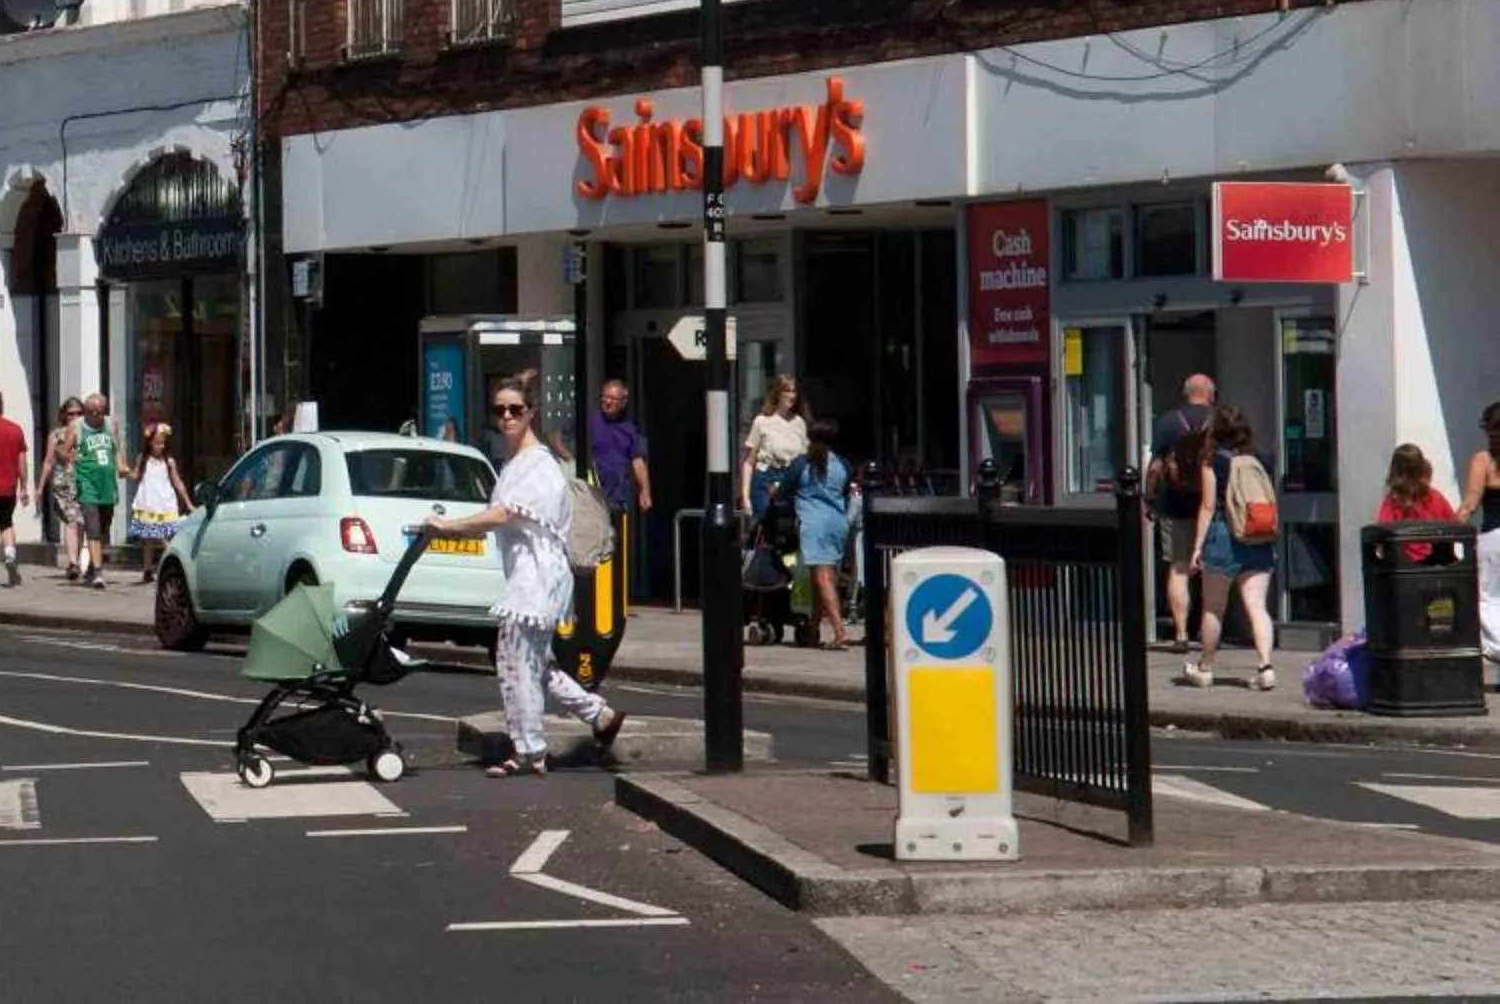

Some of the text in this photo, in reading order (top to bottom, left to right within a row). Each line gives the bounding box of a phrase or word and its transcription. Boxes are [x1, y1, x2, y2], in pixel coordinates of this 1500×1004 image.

[577, 75, 866, 204] Sainsury's
[993, 228, 1031, 257] Cash
[1226, 218, 1347, 247] Sainsbury's
[102, 234, 158, 265] Kitchens
[980, 260, 1047, 291] machine
